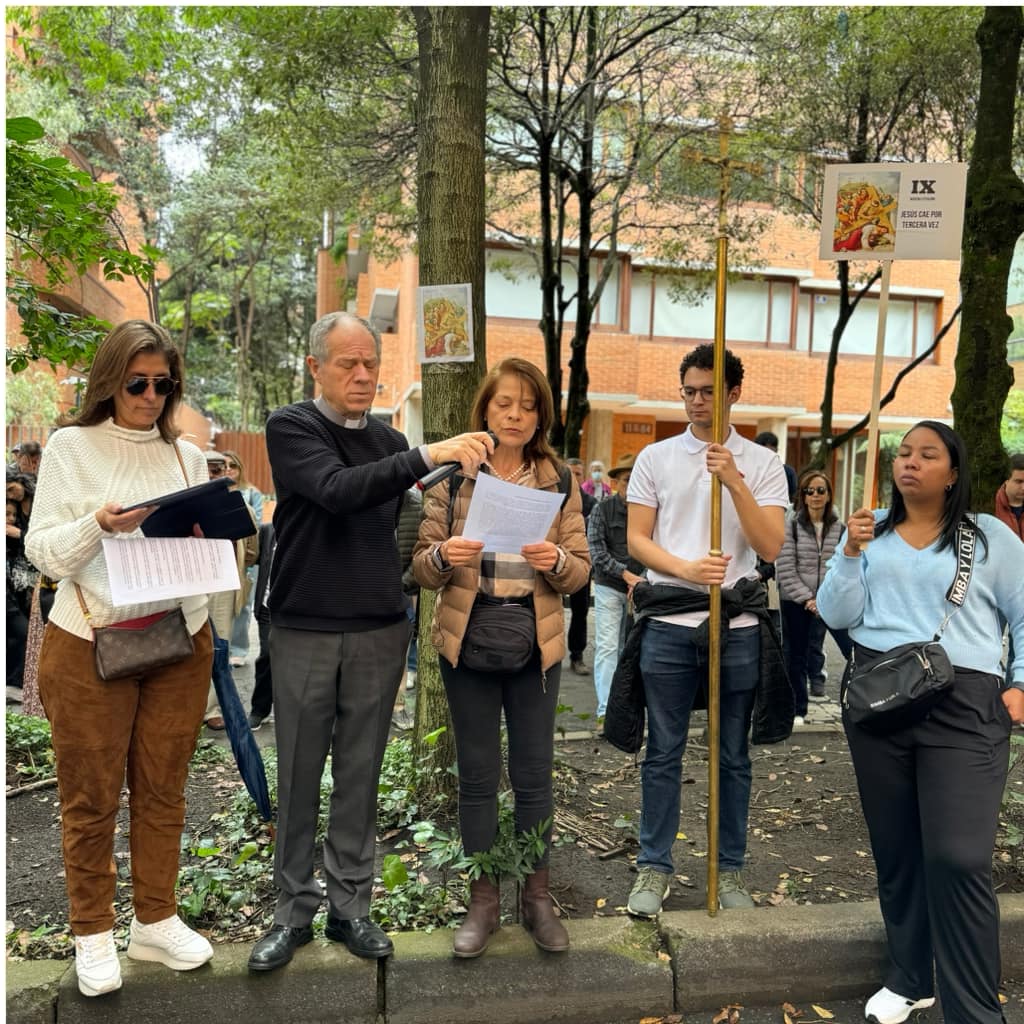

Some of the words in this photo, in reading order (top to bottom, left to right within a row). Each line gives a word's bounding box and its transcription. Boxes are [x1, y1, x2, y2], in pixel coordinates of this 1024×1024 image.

[911, 179, 937, 194] IX
[919, 210, 930, 218] CAE
[931, 210, 943, 218] POR
[902, 220, 927, 229] TERCERA
[927, 220, 940, 229] VEZ
